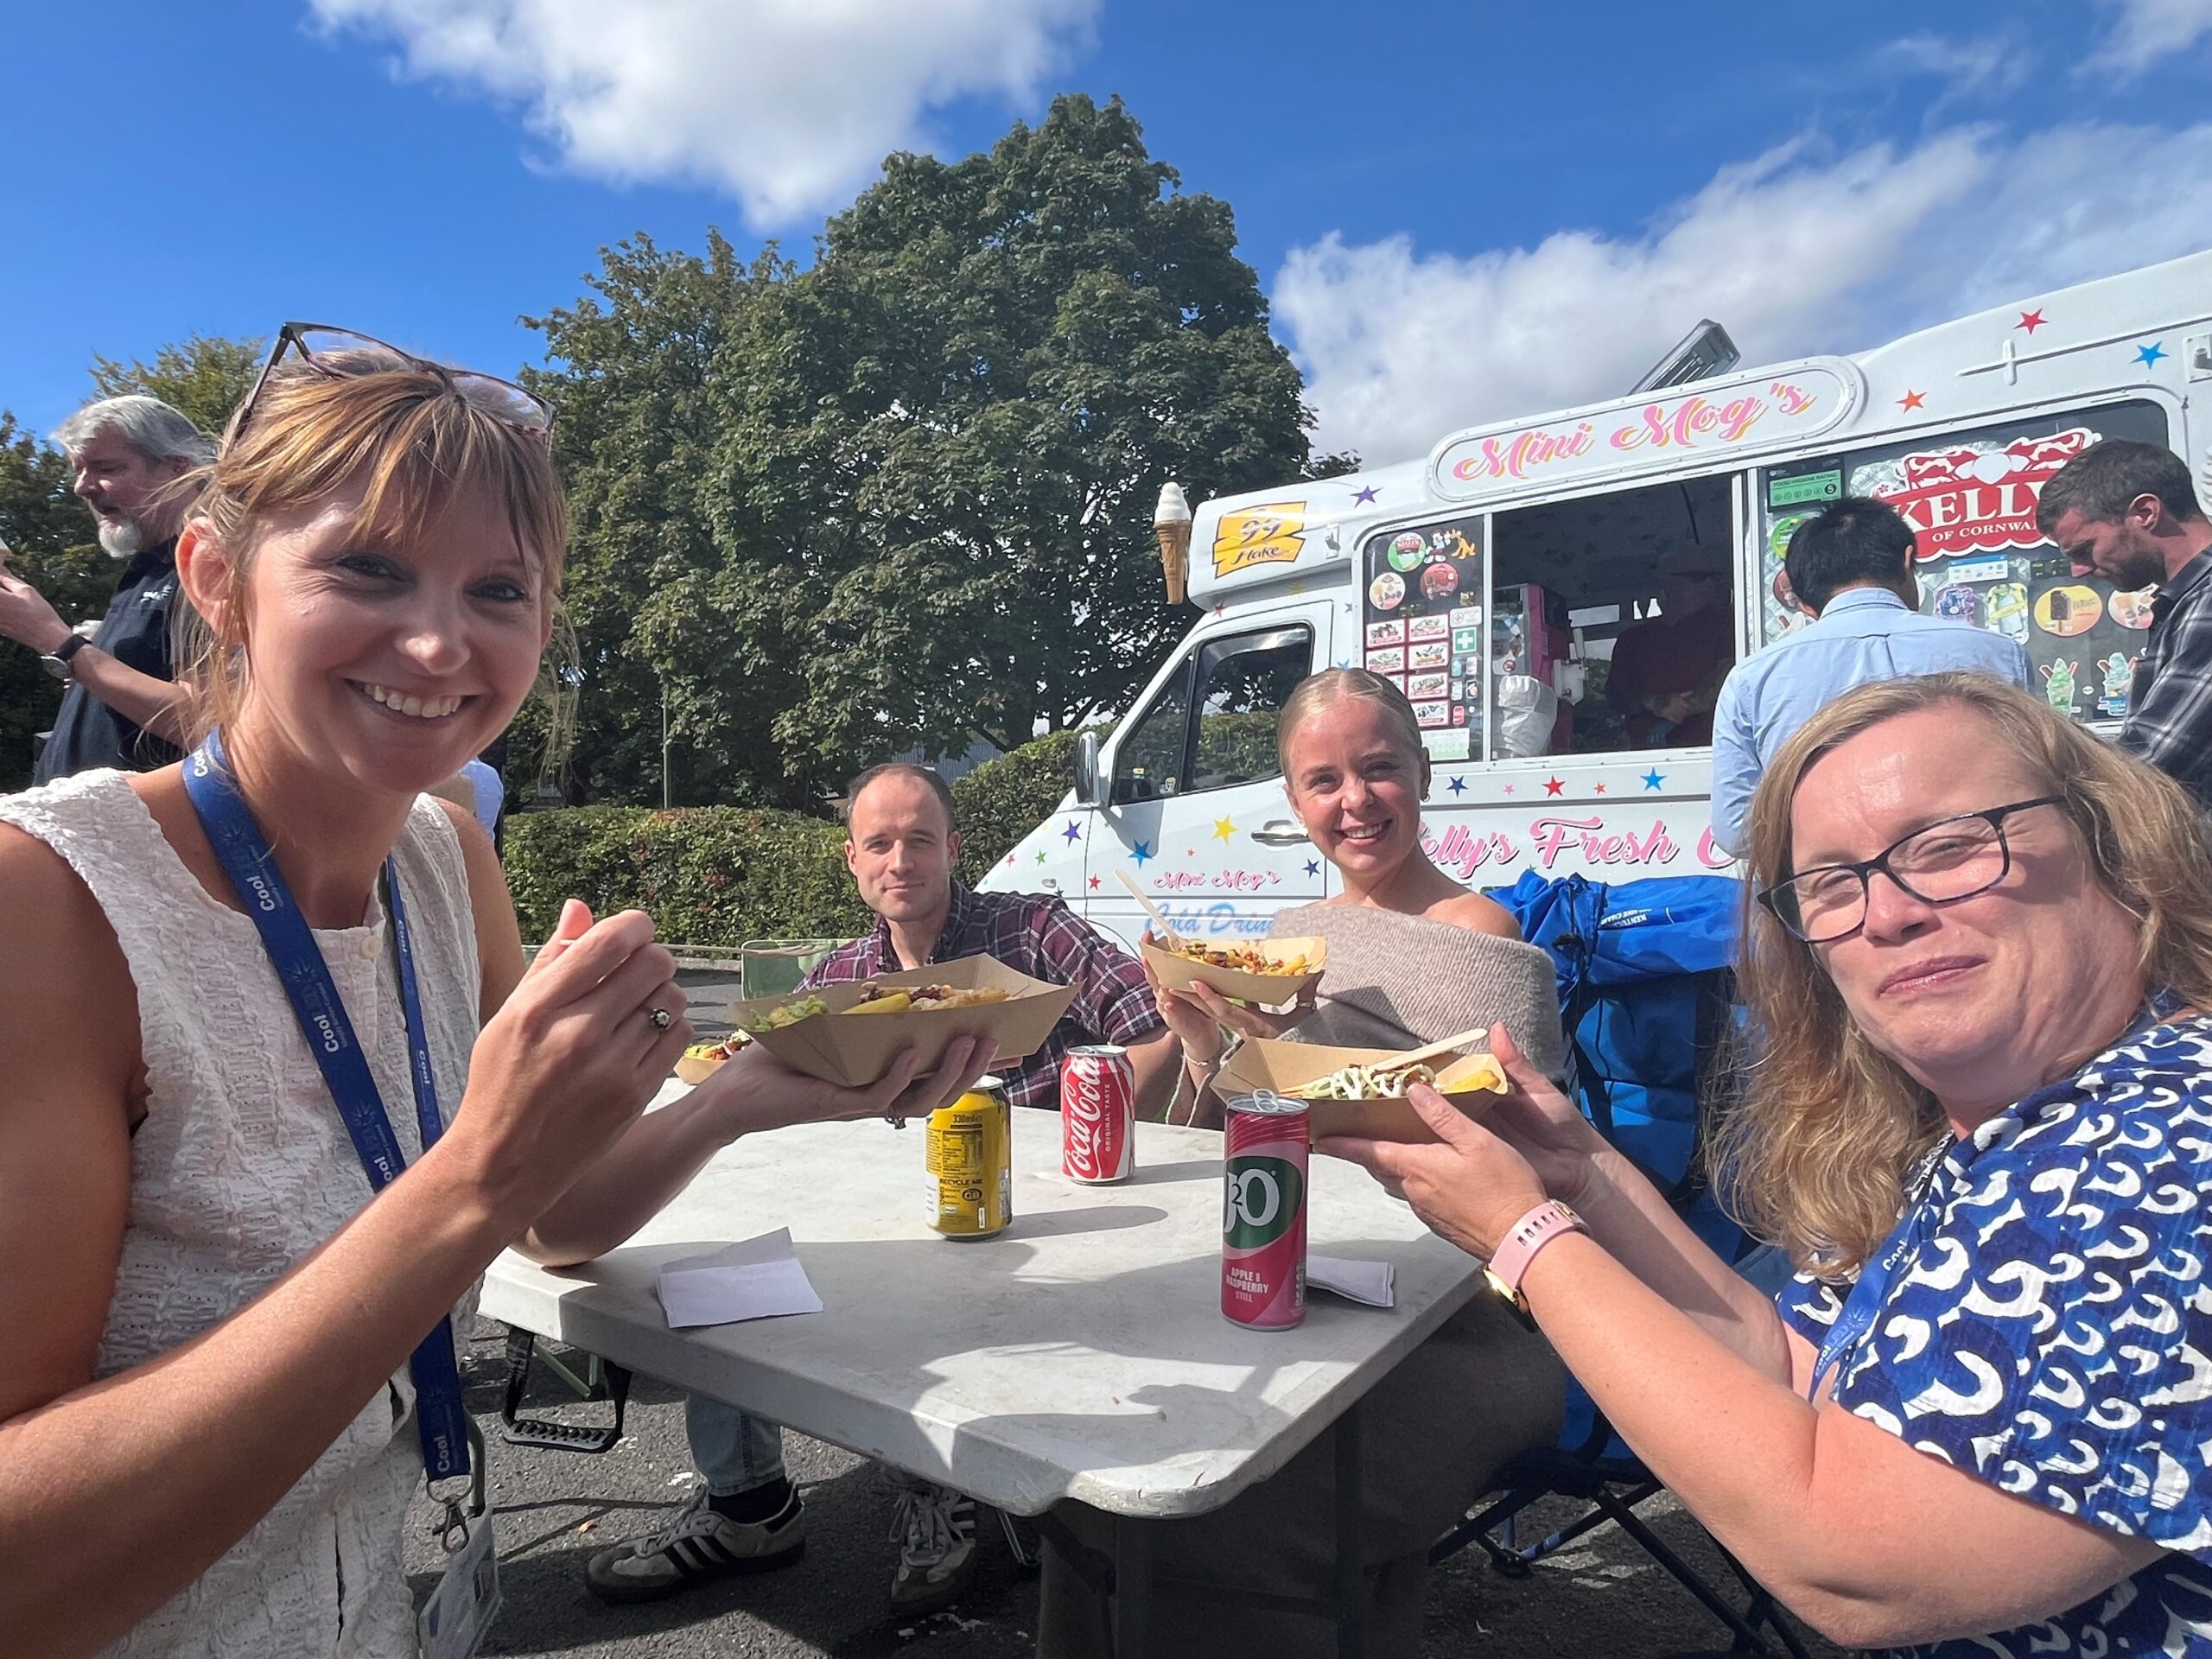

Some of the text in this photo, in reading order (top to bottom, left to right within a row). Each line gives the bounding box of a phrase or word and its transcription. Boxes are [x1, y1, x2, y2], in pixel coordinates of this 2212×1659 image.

[1452, 382, 1816, 481] Mini Mog's
[1827, 485, 1834, 493] 5
[1241, 518, 1281, 544] 99
[1931, 530, 1955, 543] OF
[1418, 821, 1519, 879] elly's
[1530, 816, 1680, 869] Fresh
[1154, 869, 1281, 892] Mini Mog's
[1206, 901, 1274, 934] Drin
[1064, 1055, 1101, 1179] Coca-Cola
[373, 1155, 395, 1183] ool
[1226, 1274, 1268, 1294] RASPBERRY
[1230, 1267, 1253, 1282] APPLE
[1236, 1290, 1253, 1303] STILL
